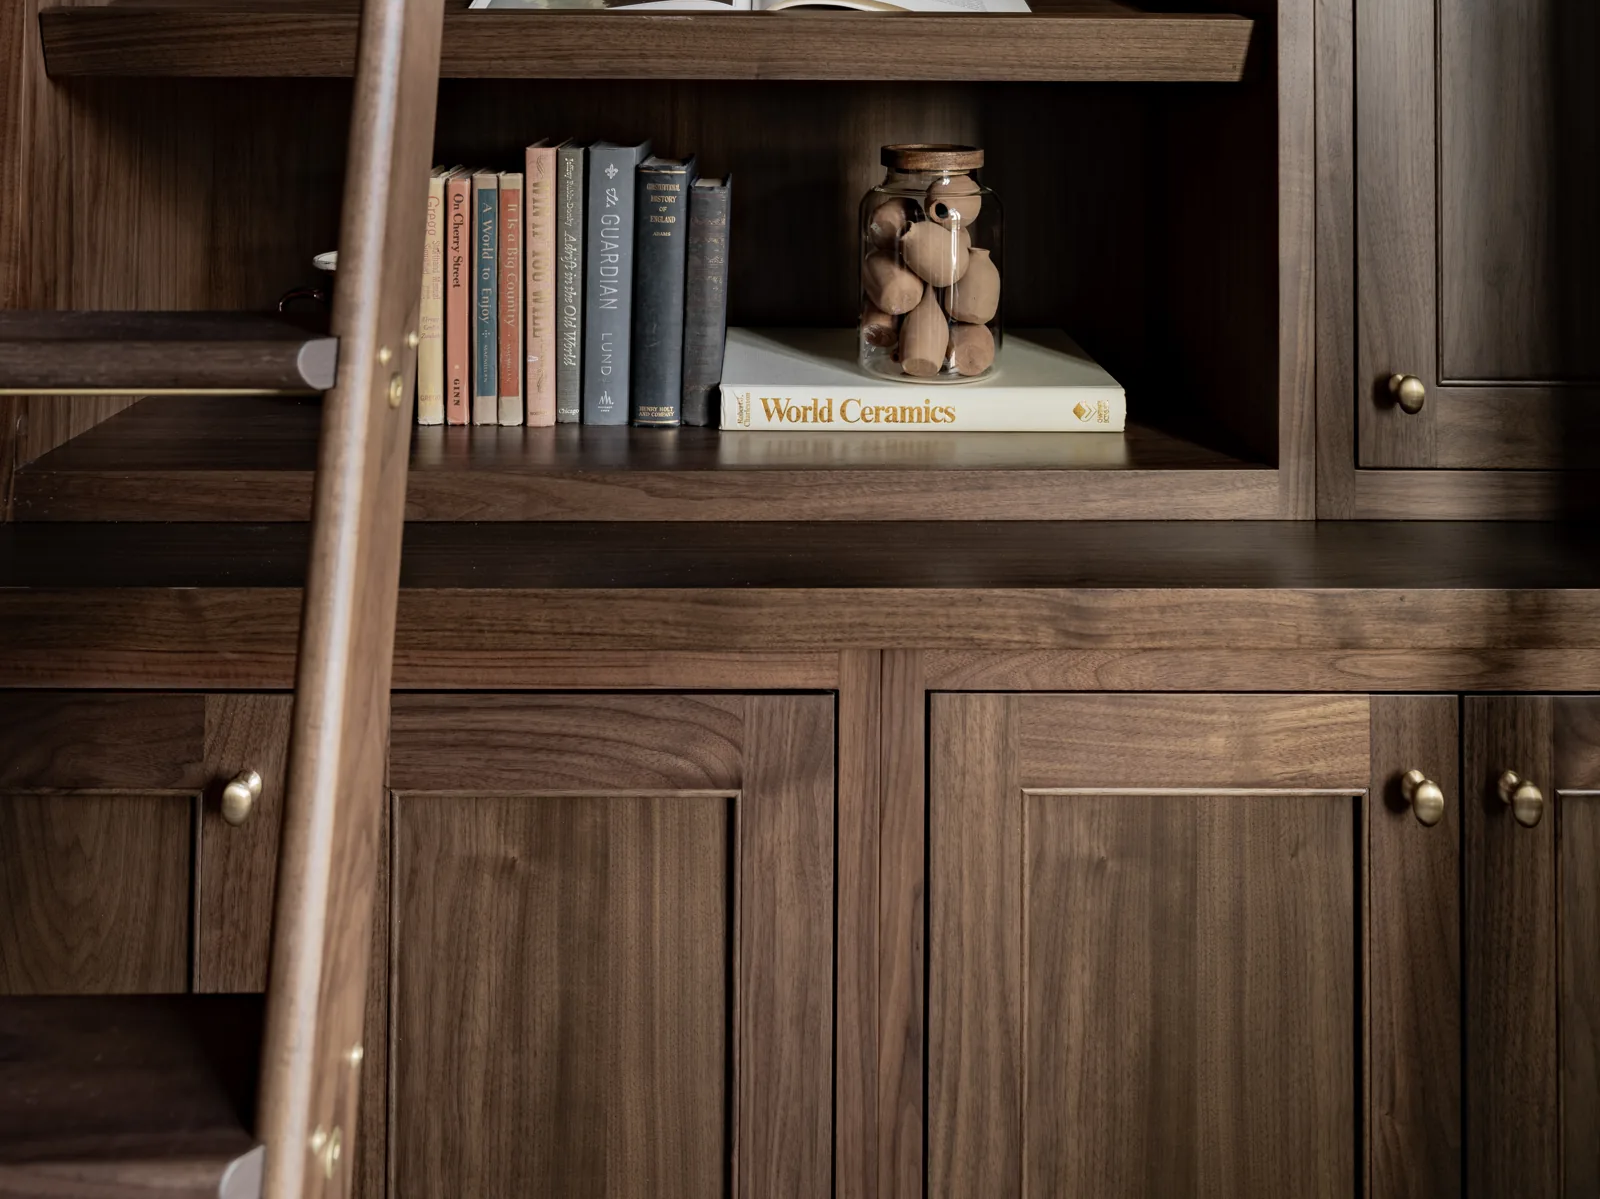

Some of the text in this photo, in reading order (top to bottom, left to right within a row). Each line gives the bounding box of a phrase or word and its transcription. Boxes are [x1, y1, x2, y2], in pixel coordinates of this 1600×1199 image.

[451, 193, 464, 288] On Cherry Street
[651, 195, 677, 203] HISTORY
[478, 202, 493, 324] A World to Enjoy
[505, 203, 518, 327] It Is a Big Country
[560, 231, 576, 366] Adrift in the Old World
[599, 214, 621, 309] GUARDIAN
[601, 332, 612, 375] LUND
[760, 398, 955, 423] World Ceramics
